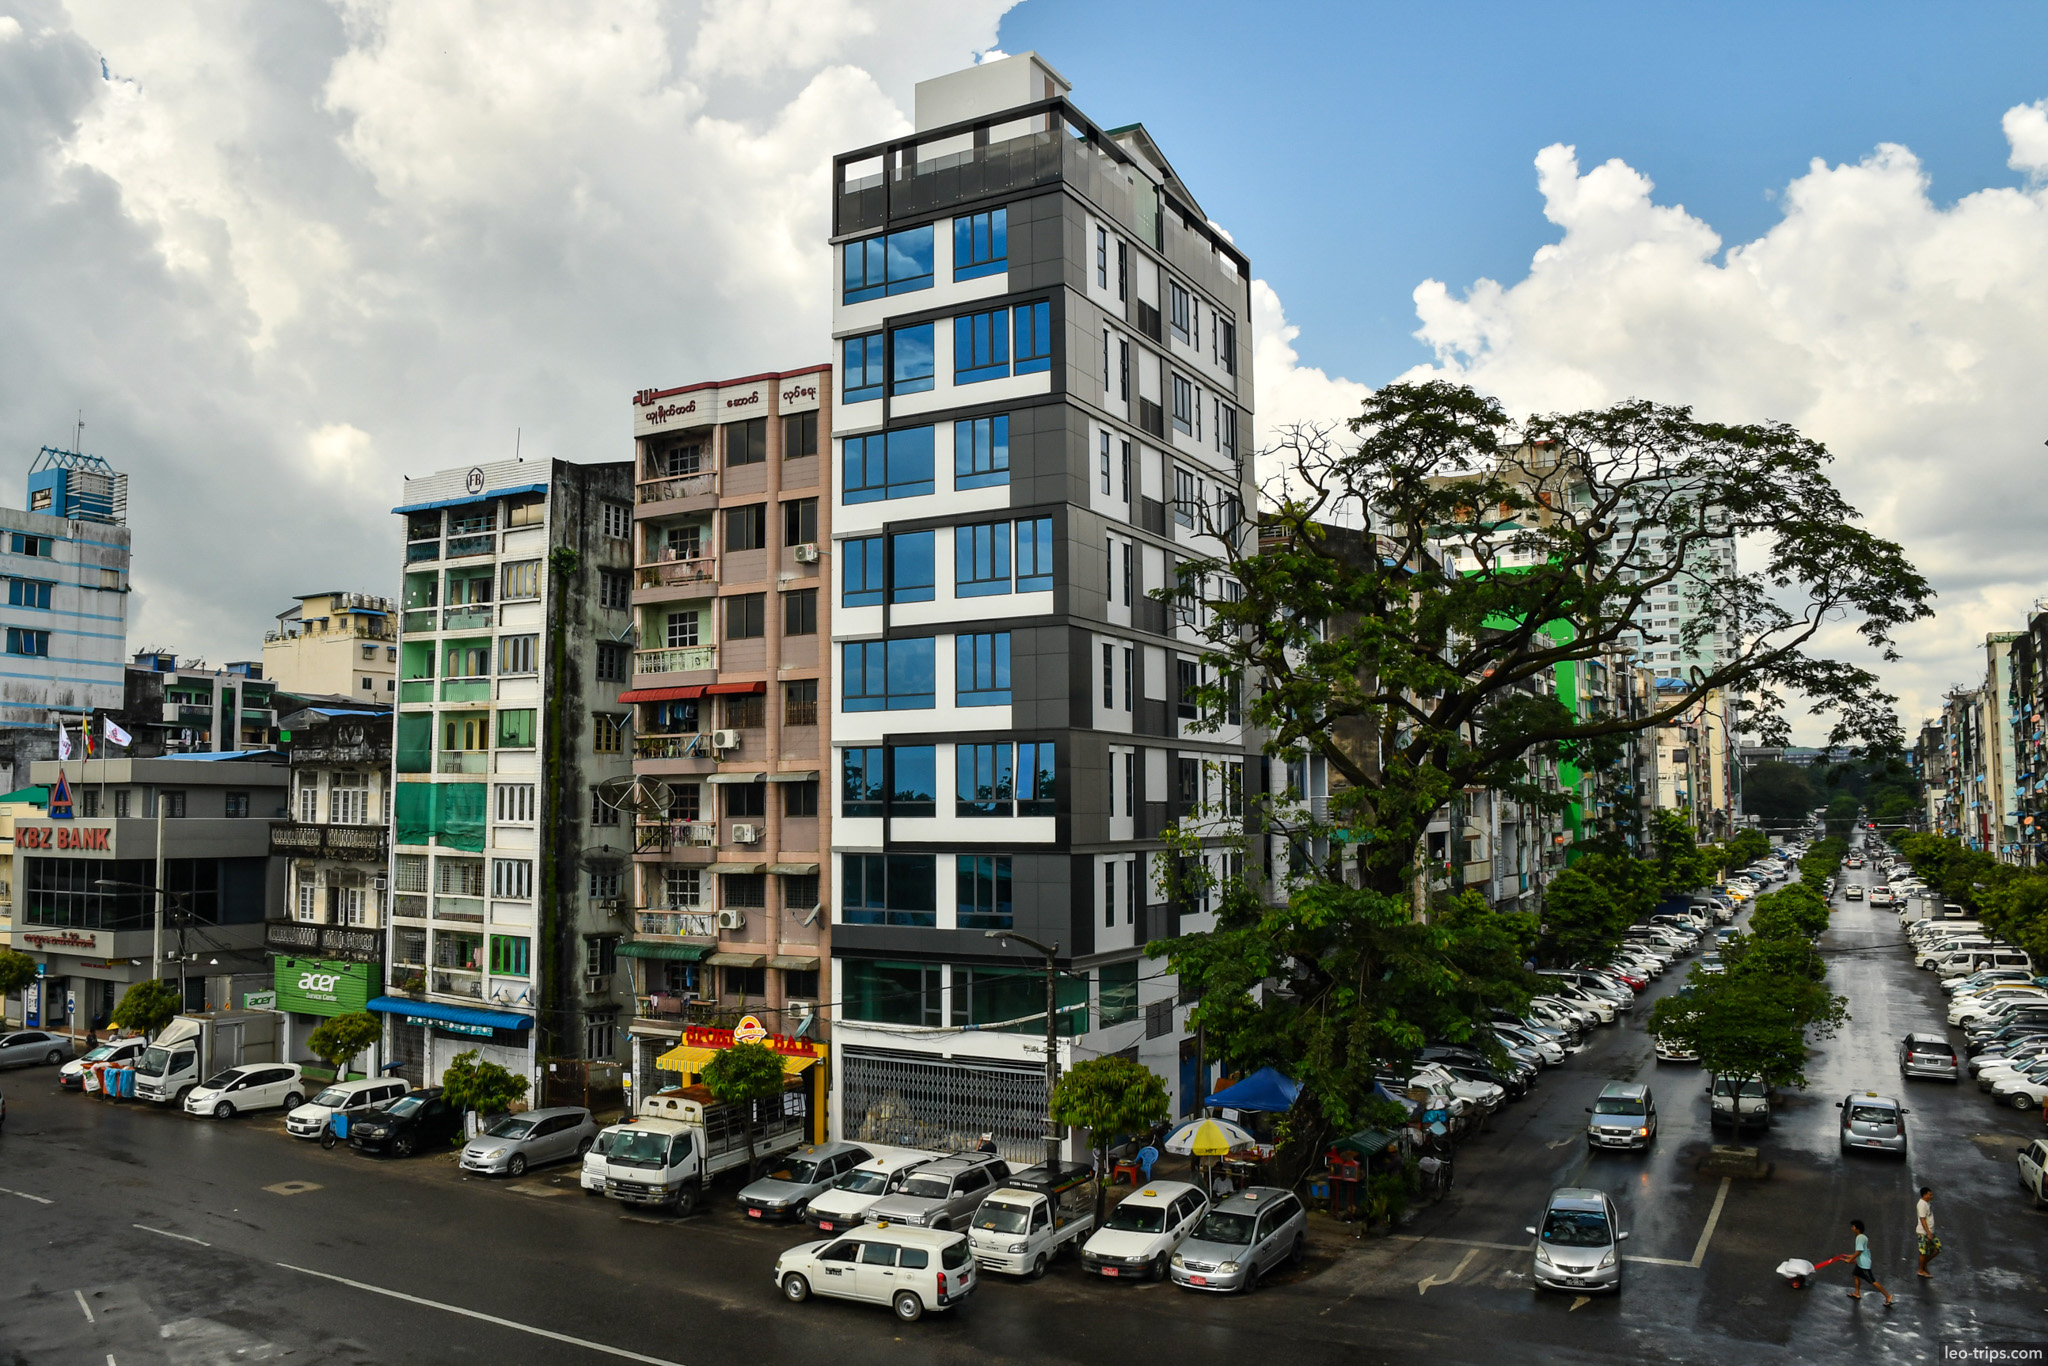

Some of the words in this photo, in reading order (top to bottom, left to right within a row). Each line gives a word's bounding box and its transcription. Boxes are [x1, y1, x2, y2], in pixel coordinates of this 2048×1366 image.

[14, 826, 53, 849] KBZ
[57, 827, 112, 851] BANK
[298, 973, 340, 992] acer
[249, 996, 274, 1006] acer
[686, 1025, 735, 1046] SPORT
[772, 1033, 814, 1053] BAR
